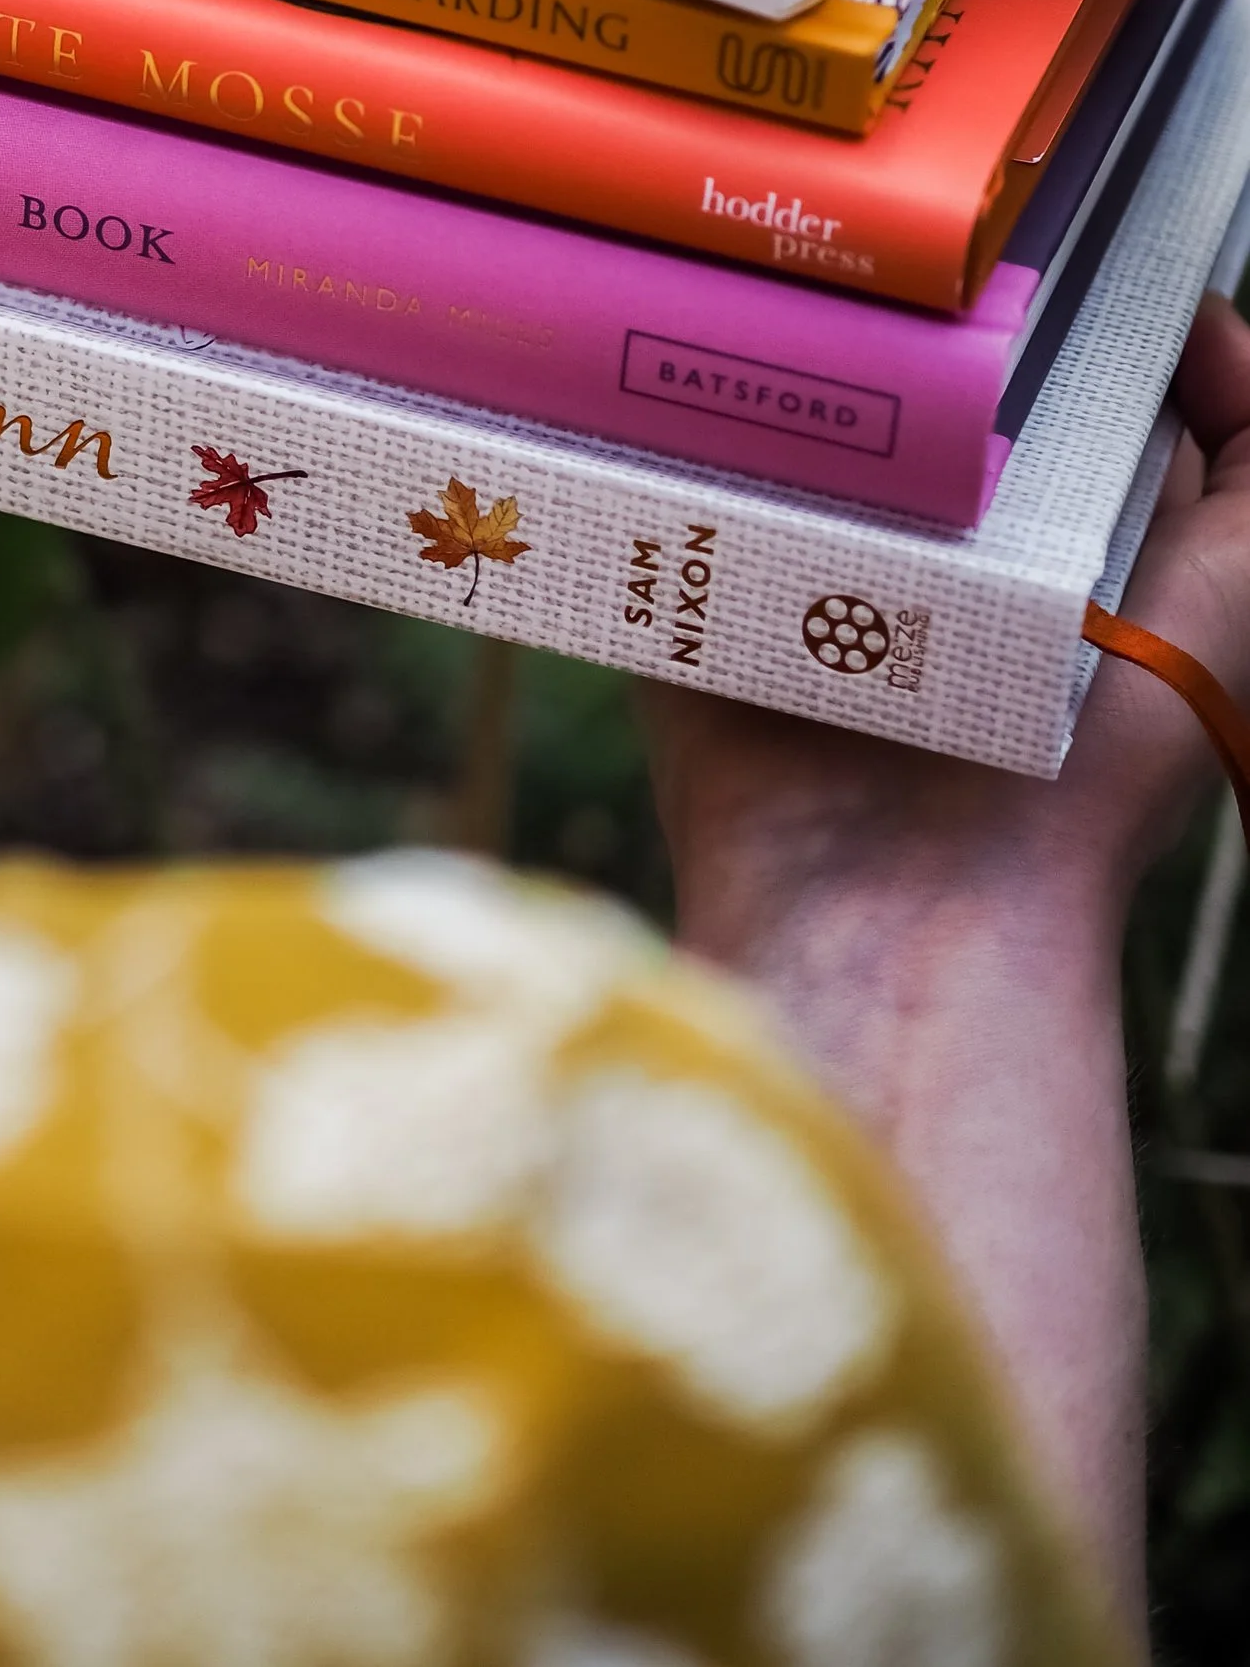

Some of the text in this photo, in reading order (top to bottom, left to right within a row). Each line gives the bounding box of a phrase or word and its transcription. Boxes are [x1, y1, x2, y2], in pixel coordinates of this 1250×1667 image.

[138, 49, 424, 164] MOSSE
[18, 194, 176, 265] BOOK
[702, 176, 842, 242] hodder
[247, 256, 421, 317] MIRANDA
[773, 233, 875, 276] press
[658, 360, 860, 430] BATSFORD
[624, 539, 662, 628] SAM
[669, 524, 717, 668] NIXON
